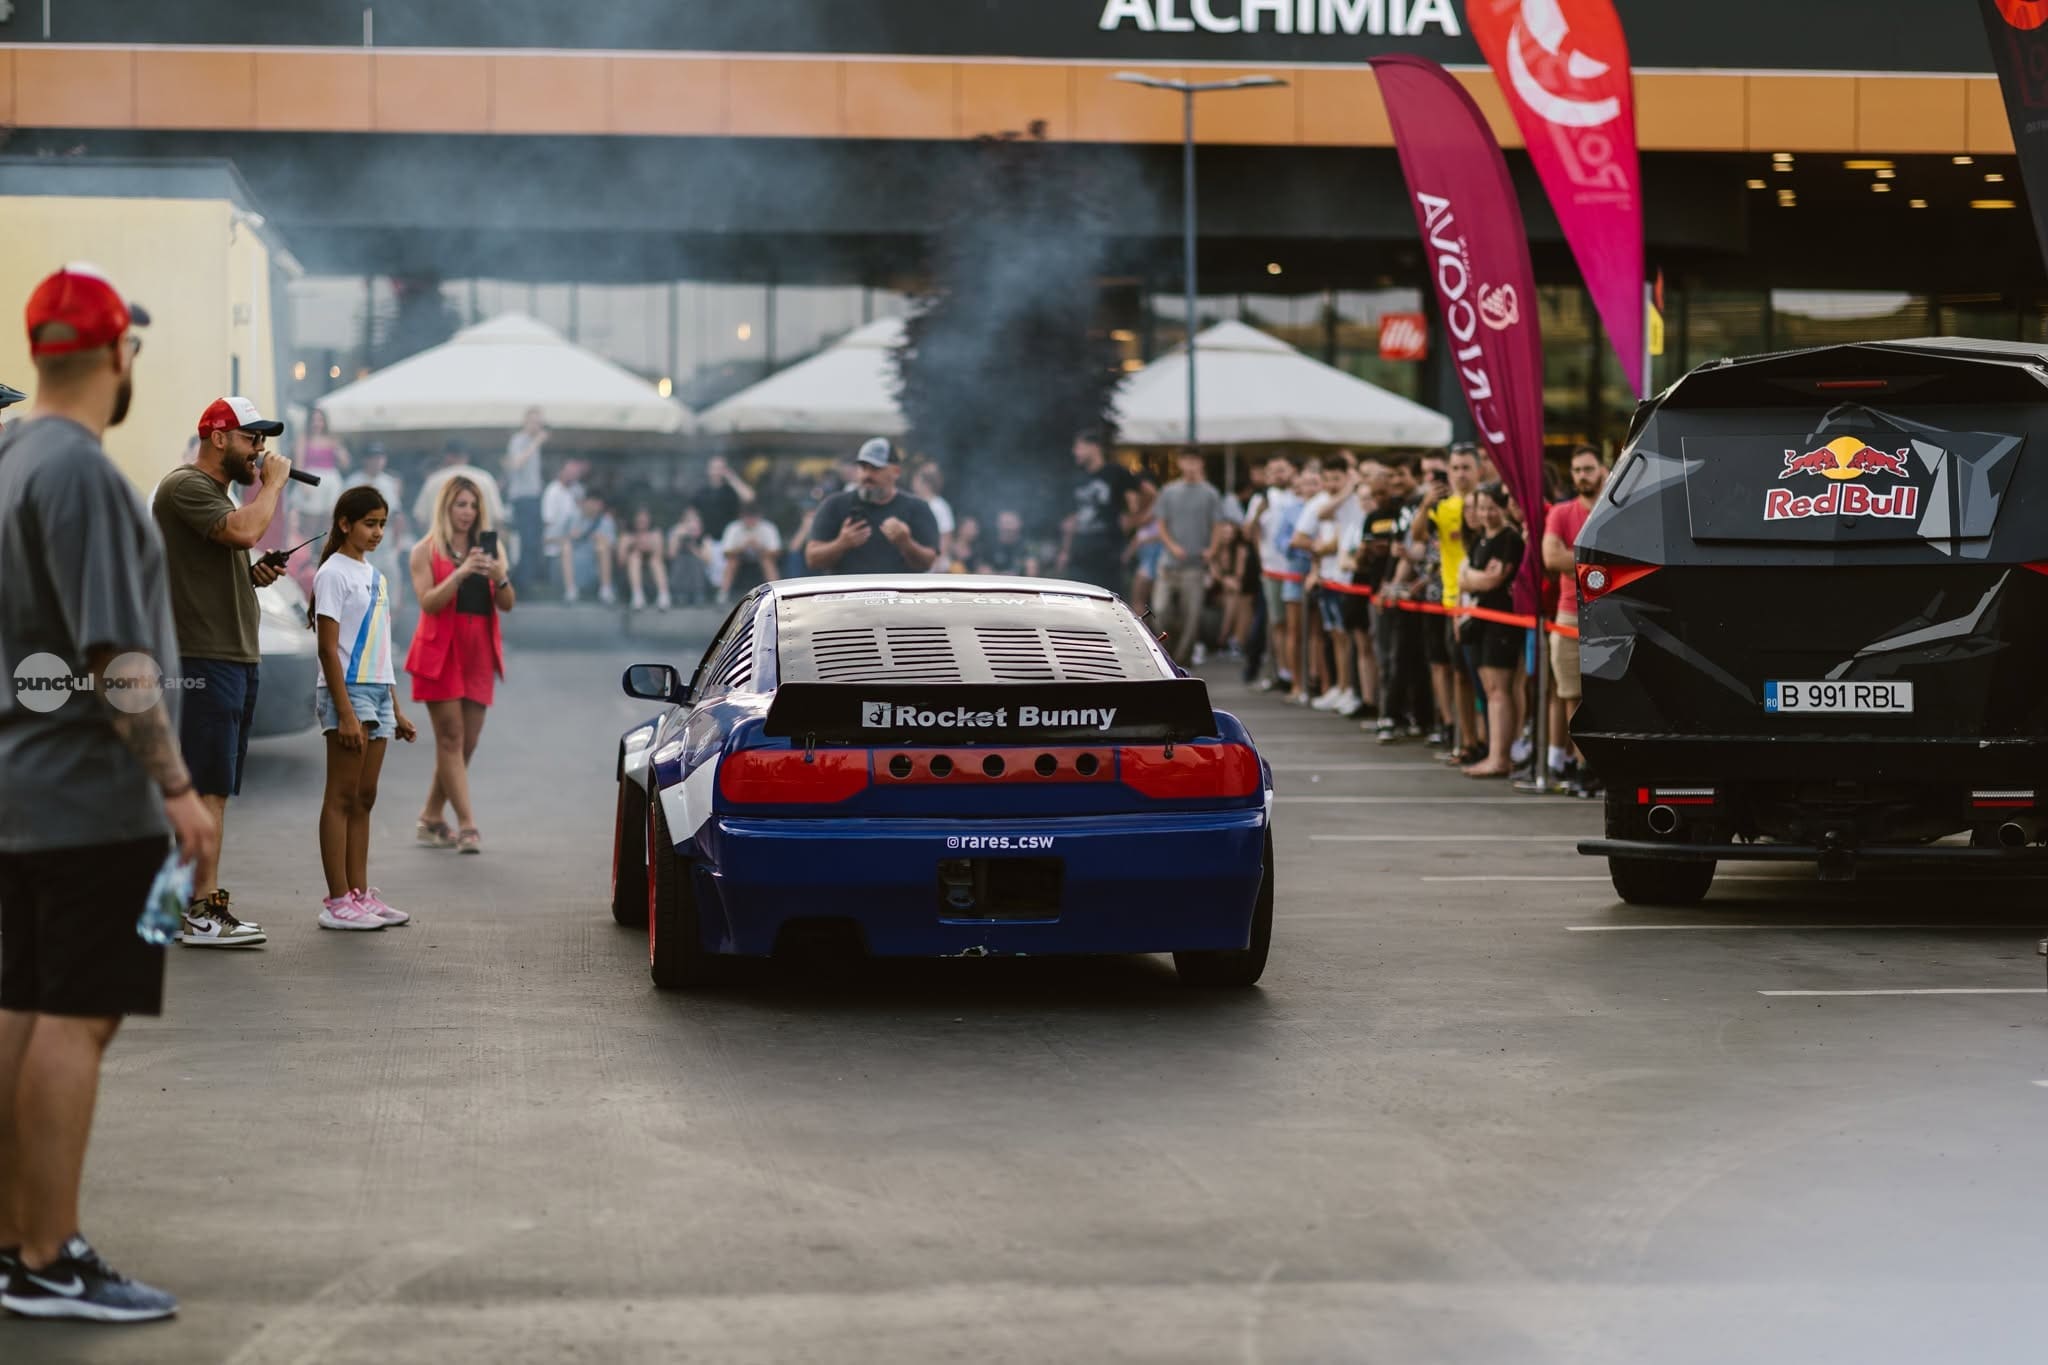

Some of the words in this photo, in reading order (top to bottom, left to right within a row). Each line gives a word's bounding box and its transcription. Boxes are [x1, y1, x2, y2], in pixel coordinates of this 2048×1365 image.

[1098, 0, 1462, 37] ALCHIMIA
[1765, 484, 1838, 519] Red
[1841, 484, 1918, 519] Bull
[1782, 685, 1799, 708] B
[1809, 685, 1846, 708] 991
[1855, 685, 1905, 709] RBL
[895, 704, 1008, 727] Rocket
[1019, 705, 1118, 730] Bunny
[960, 836, 1054, 849] rares_csw
